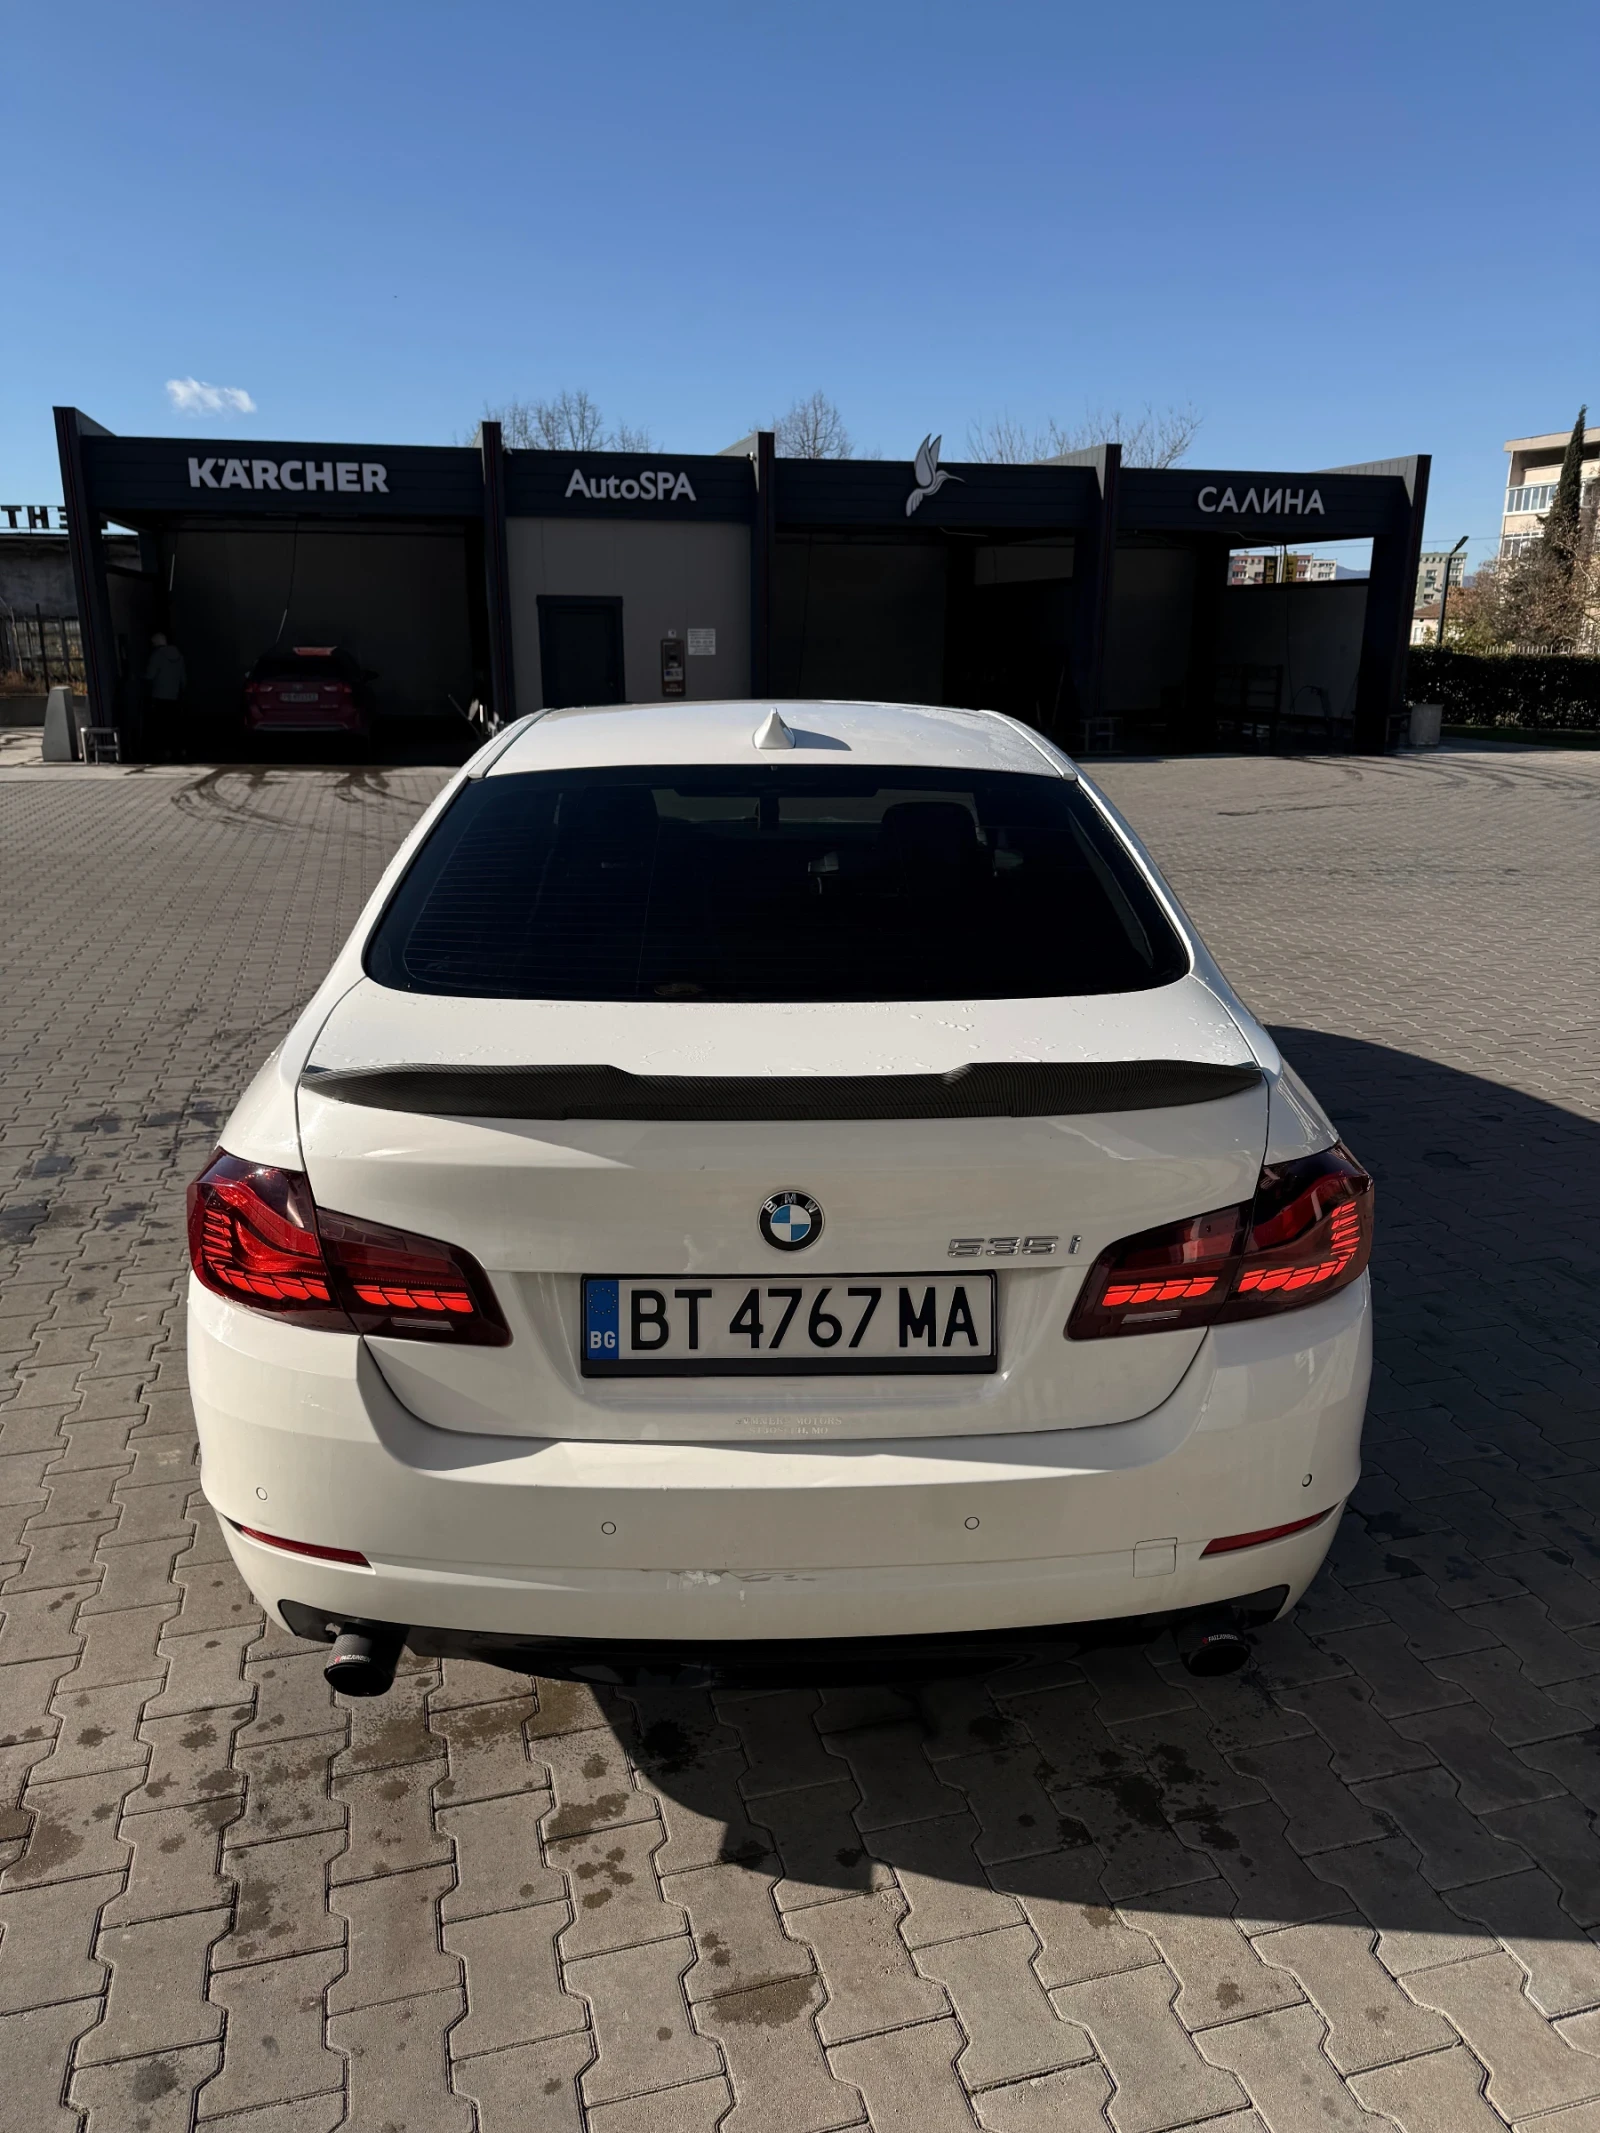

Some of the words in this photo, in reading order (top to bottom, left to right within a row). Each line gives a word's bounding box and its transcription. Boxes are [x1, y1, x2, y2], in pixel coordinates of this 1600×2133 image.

[188, 457, 390, 493] KÄRCHER
[564, 468, 697, 501] AutoSPA
[1197, 486, 1326, 515] САЛИНА
[764, 1193, 818, 1214] BMW
[630, 1288, 713, 1351] BT
[729, 1287, 882, 1349] 4767
[898, 1286, 979, 1348] MA
[590, 1331, 616, 1349] BG
[796, 1416, 842, 1426] MOTORS
